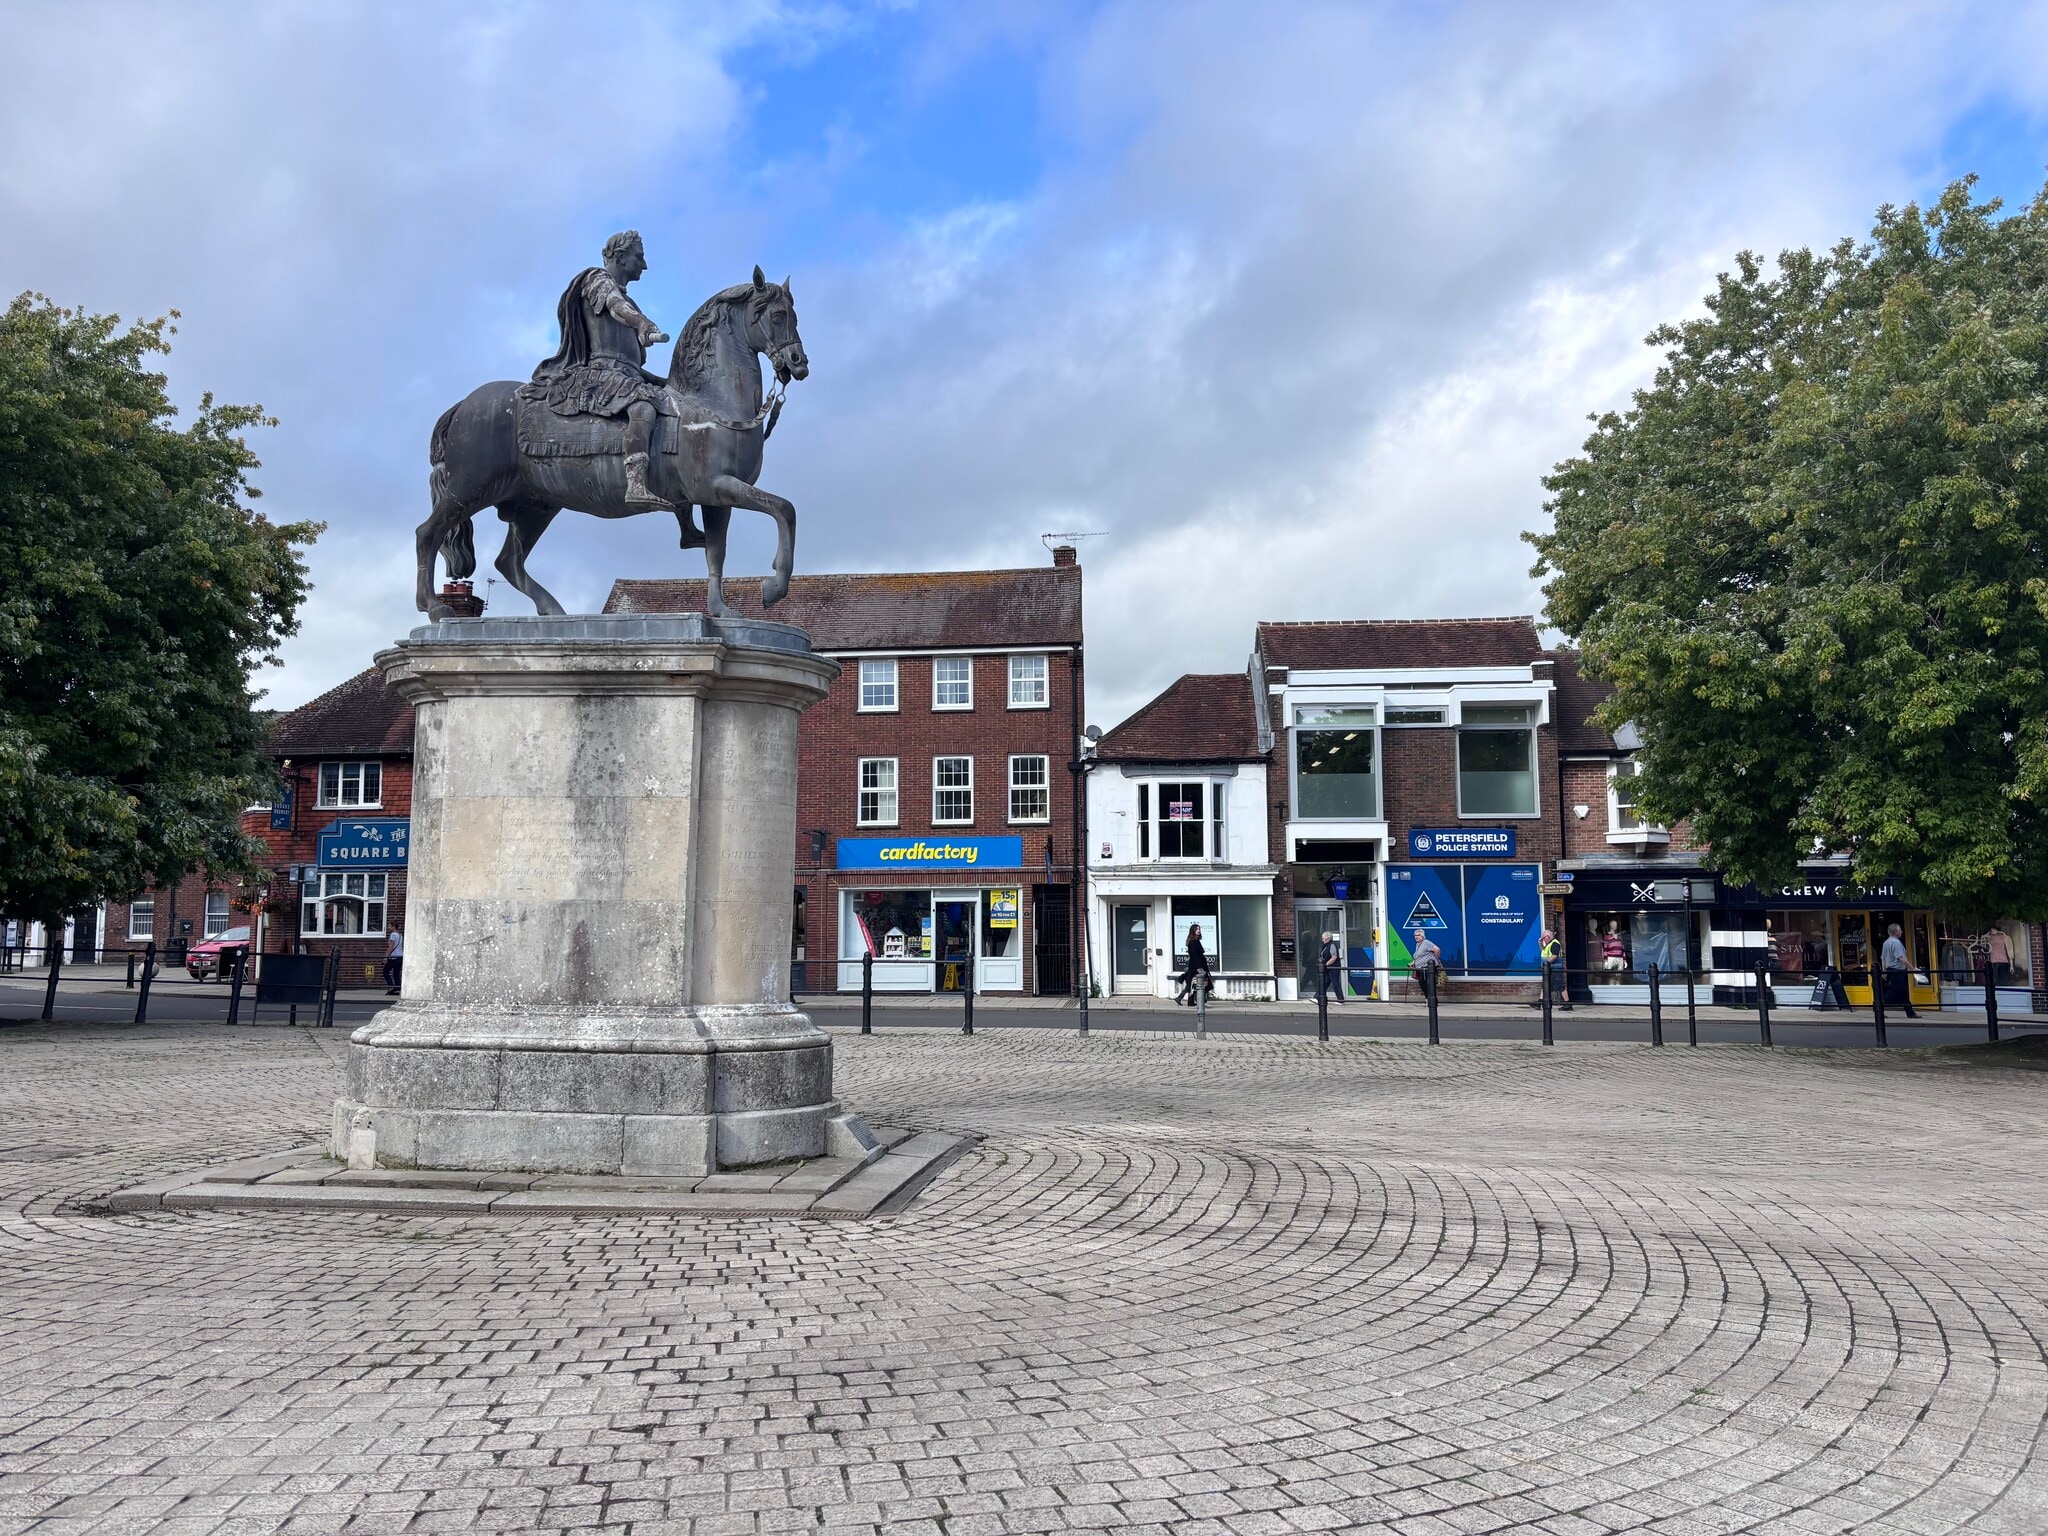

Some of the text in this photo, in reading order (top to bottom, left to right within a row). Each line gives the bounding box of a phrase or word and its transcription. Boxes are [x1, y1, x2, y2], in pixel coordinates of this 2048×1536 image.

[391, 829, 407, 841] THE
[1435, 833, 1508, 843] PETERSFIELD
[330, 846, 390, 860] SQUARE
[879, 842, 979, 863] cardfactory
[1435, 844, 1508, 852] POLICE STATION
[1001, 891, 1016, 900] 15p
[1781, 885, 1827, 896] CREW
